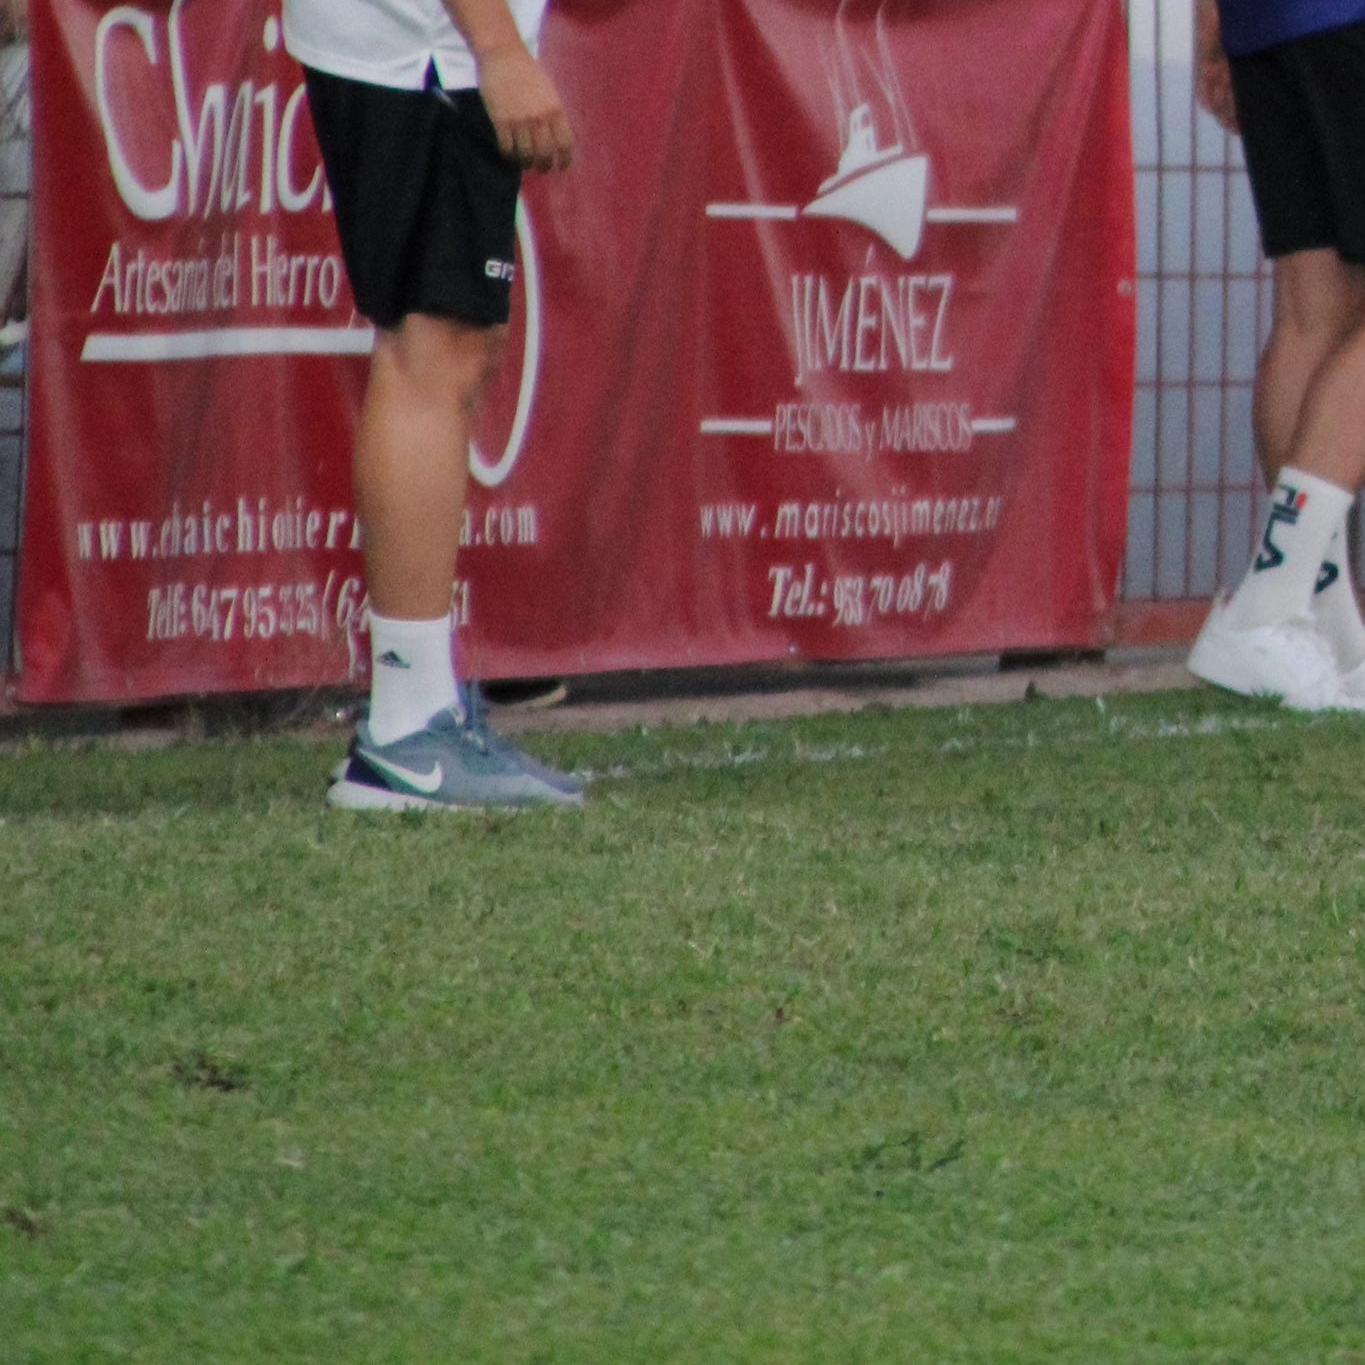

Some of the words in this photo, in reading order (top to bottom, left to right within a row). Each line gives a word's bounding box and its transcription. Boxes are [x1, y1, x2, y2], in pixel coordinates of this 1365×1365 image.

[213, 233, 239, 308] del
[791, 244, 955, 388] JIMÉNEZ
[767, 563, 827, 618] Tel.:
